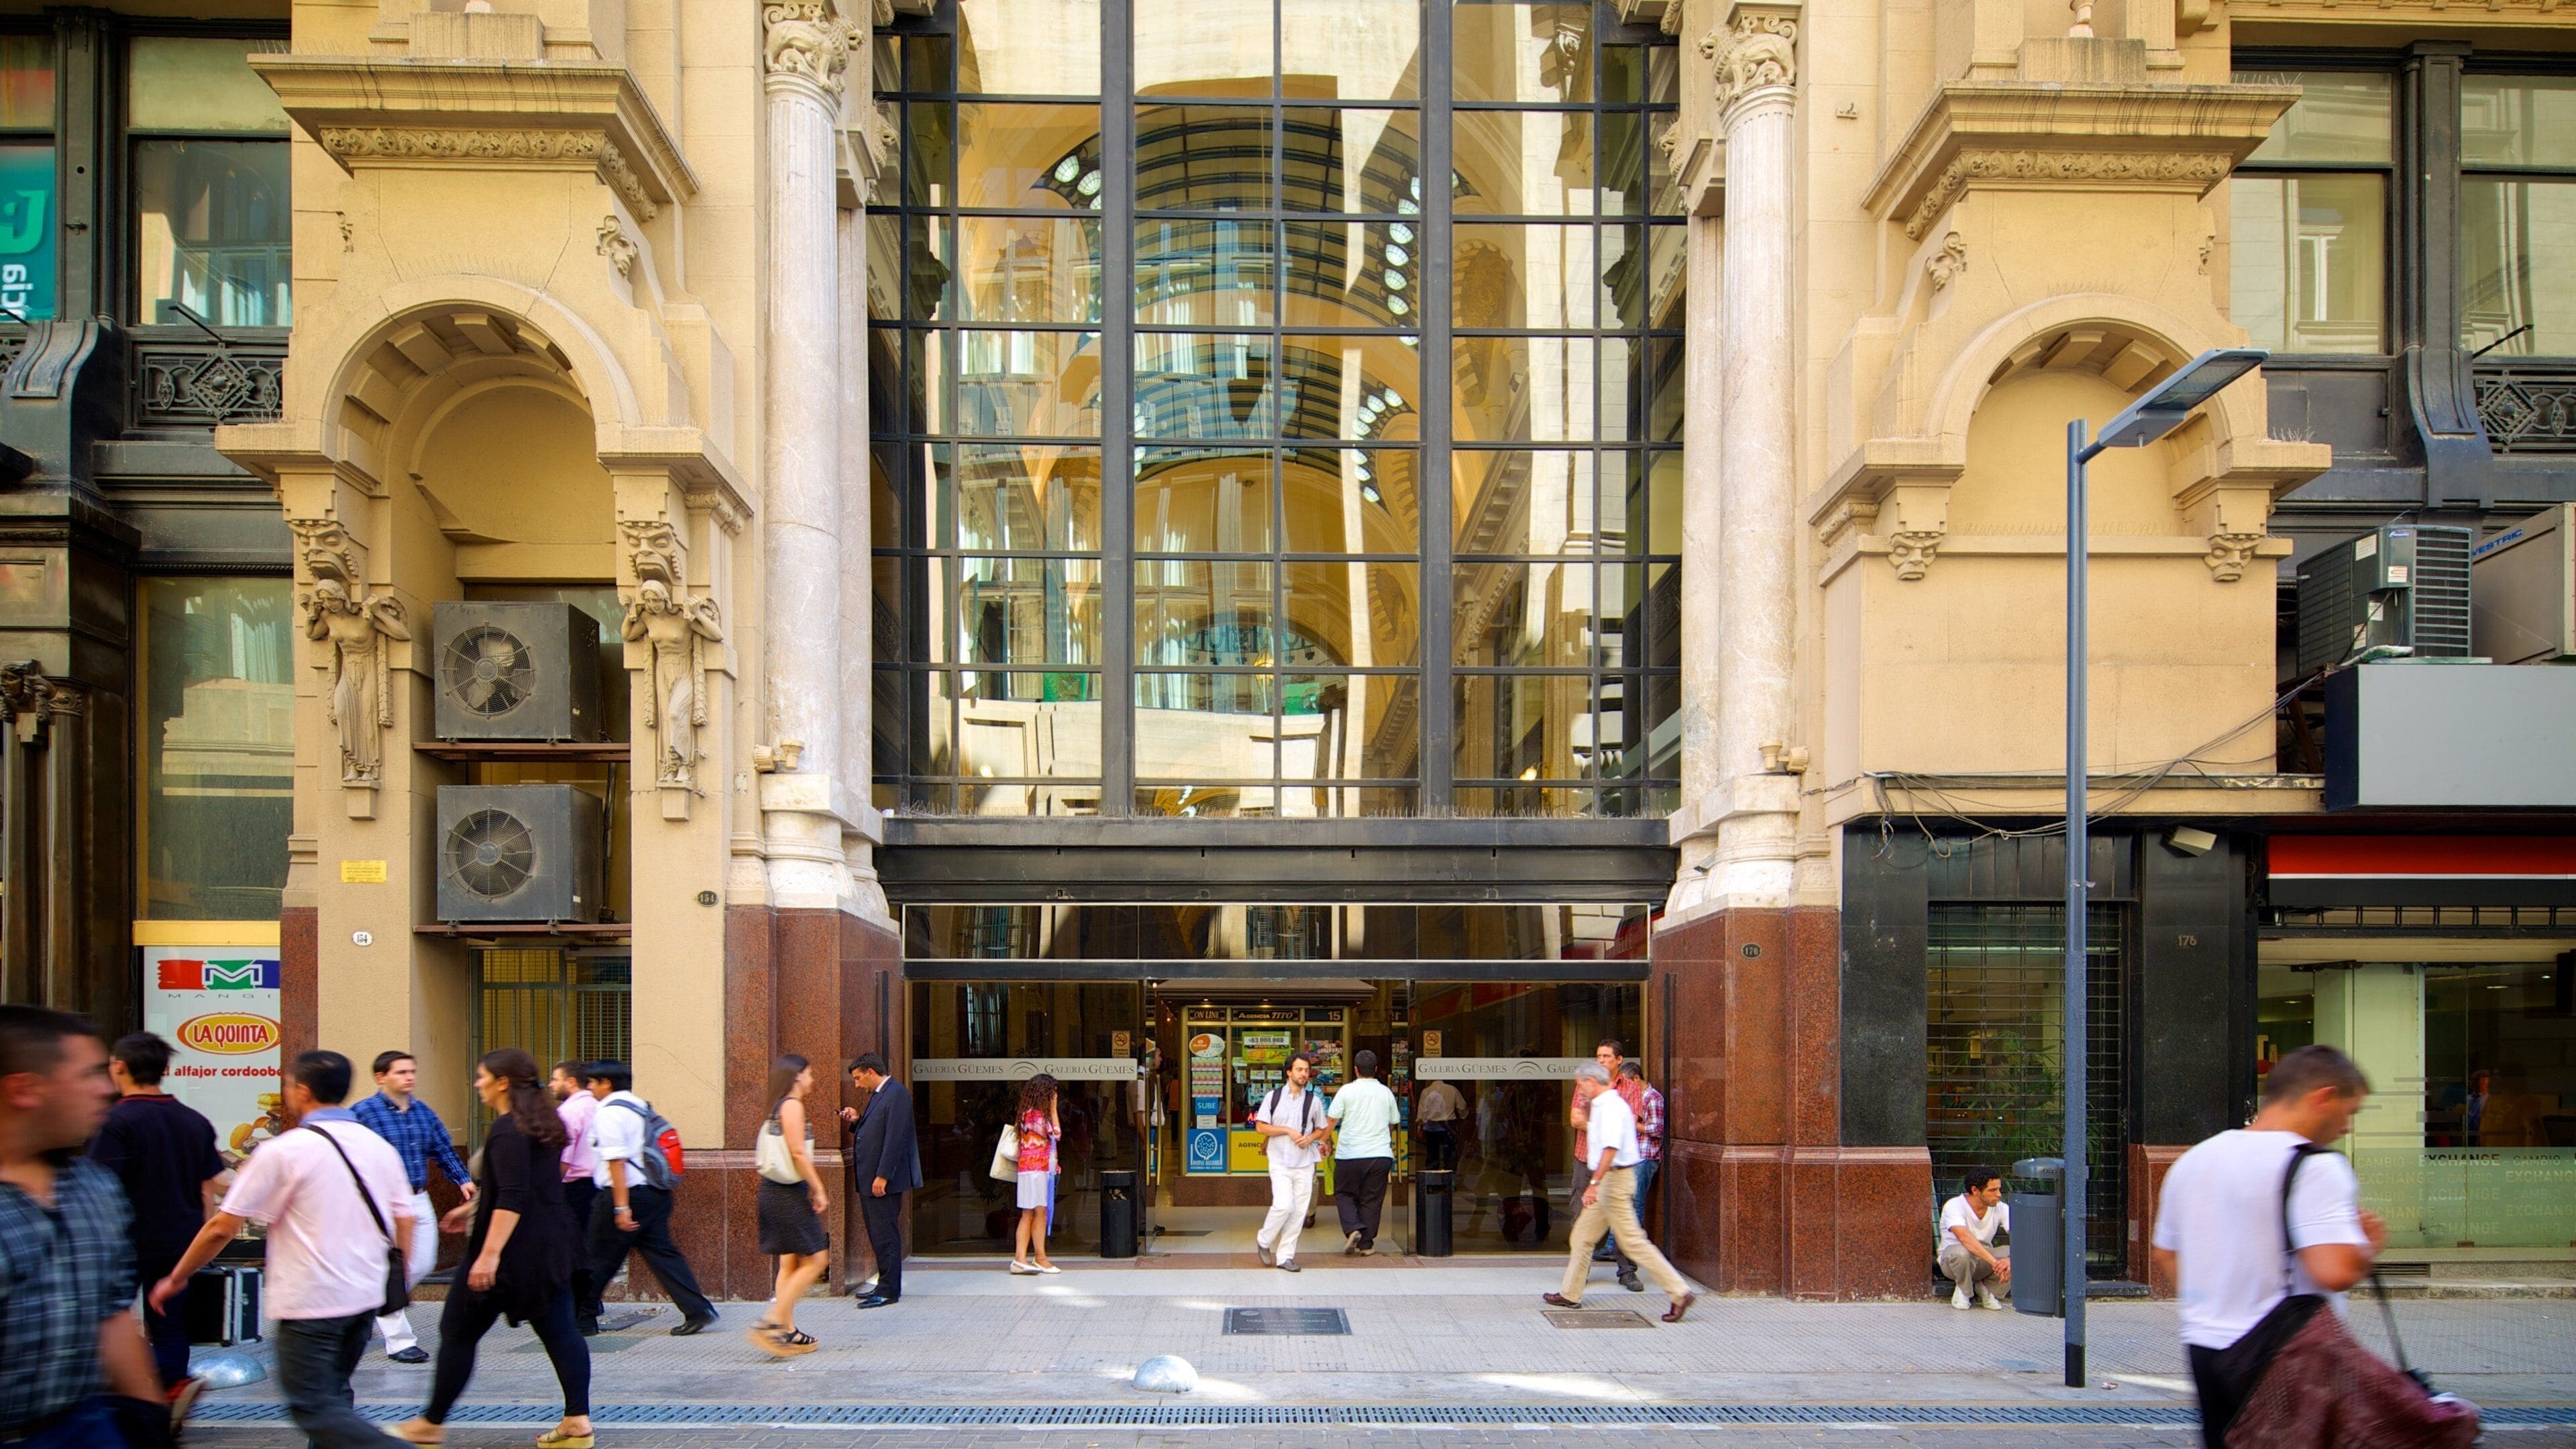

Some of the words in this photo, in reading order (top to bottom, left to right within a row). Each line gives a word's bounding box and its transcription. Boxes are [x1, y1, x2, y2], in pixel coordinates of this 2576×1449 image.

[700, 894, 714, 902] 154
[357, 934, 368, 943] 154
[2178, 935, 2197, 946] 176
[1745, 947, 1758, 955] 170
[1194, 1012, 1205, 1020] ON
[1205, 1012, 1220, 1020] LINE
[1272, 1012, 1293, 1020] TITO
[1327, 1011, 1341, 1021] 15
[193, 1024, 212, 1043] LA
[214, 1024, 269, 1048] QUINTA
[174, 1065, 218, 1079] alfajor
[913, 1063, 957, 1074] GALERIA
[957, 1063, 1004, 1075] GÜEMES
[1044, 1063, 1087, 1074] GALERIA
[1088, 1063, 1135, 1075] GÜEMES
[1417, 1063, 1461, 1074] GALERIA
[1461, 1063, 1507, 1074] GÜEMES
[2357, 1157, 2404, 1168] CAMBIO
[2418, 1154, 2500, 1167] EXCHANGE
[2513, 1155, 2561, 1166] CAMBIO
